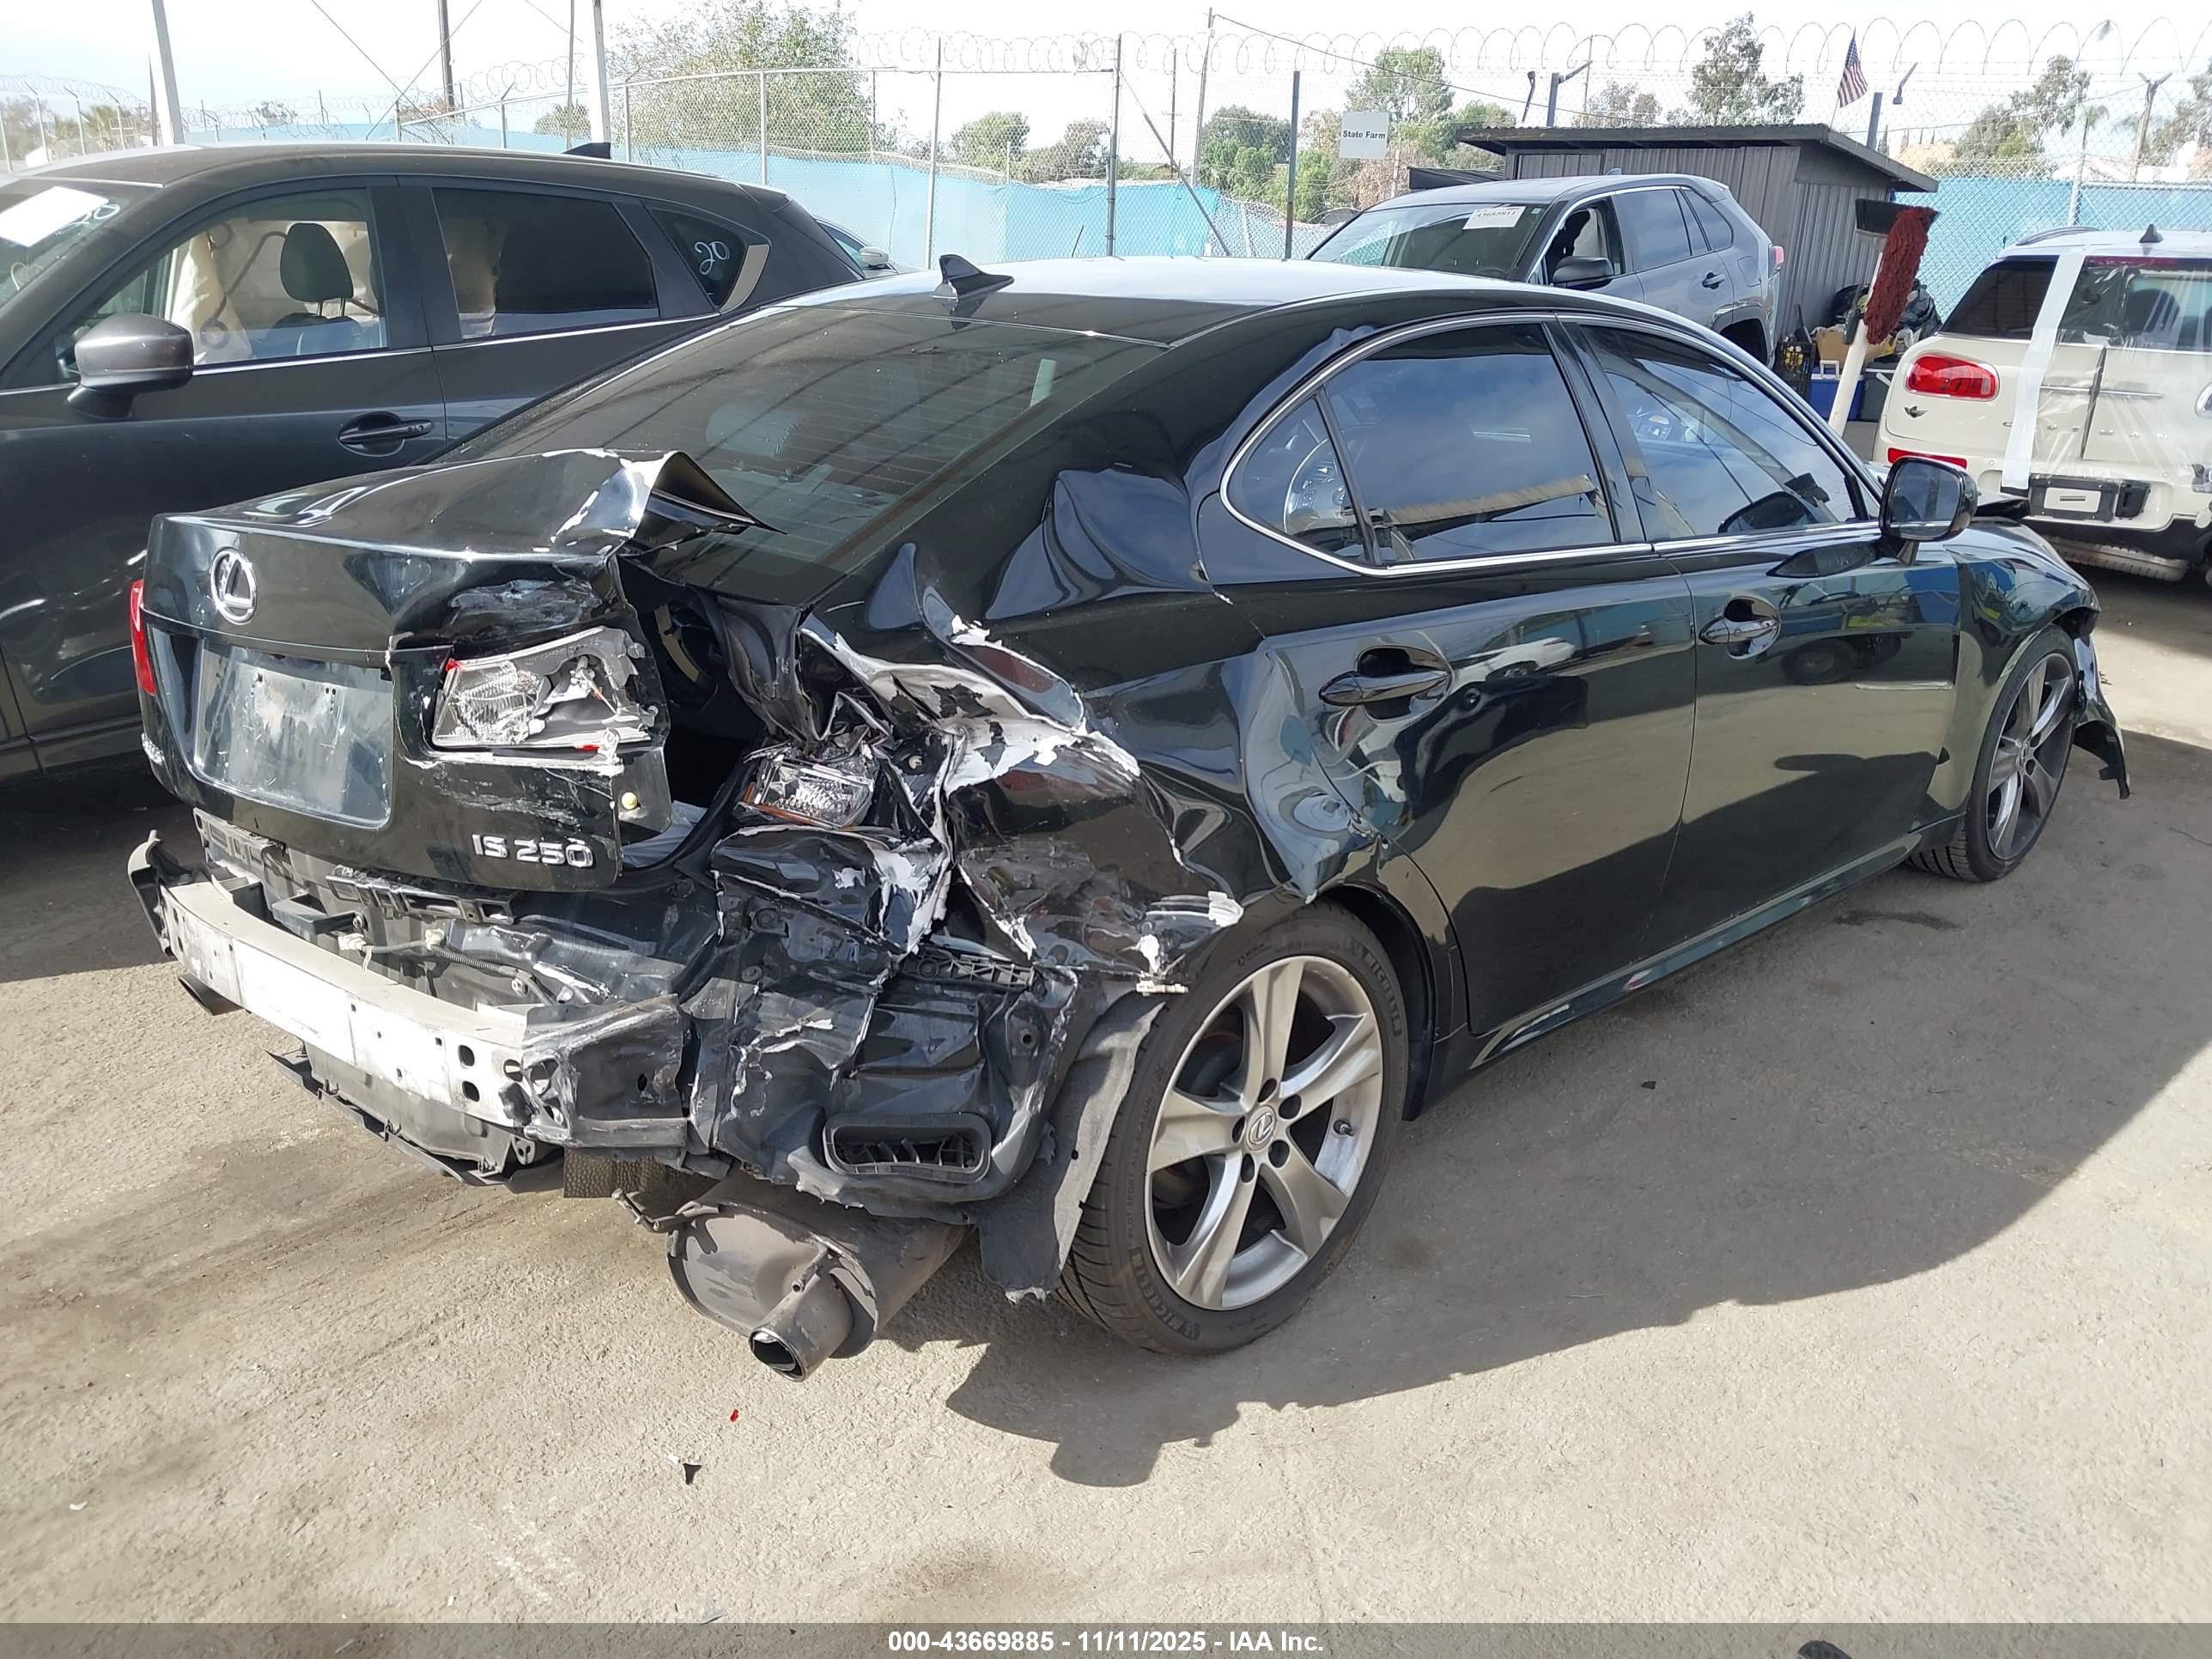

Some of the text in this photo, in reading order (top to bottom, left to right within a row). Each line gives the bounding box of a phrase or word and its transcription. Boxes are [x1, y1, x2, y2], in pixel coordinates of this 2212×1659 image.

[1342, 130, 1386, 139] State Farm
[471, 834, 594, 868] IS 250
